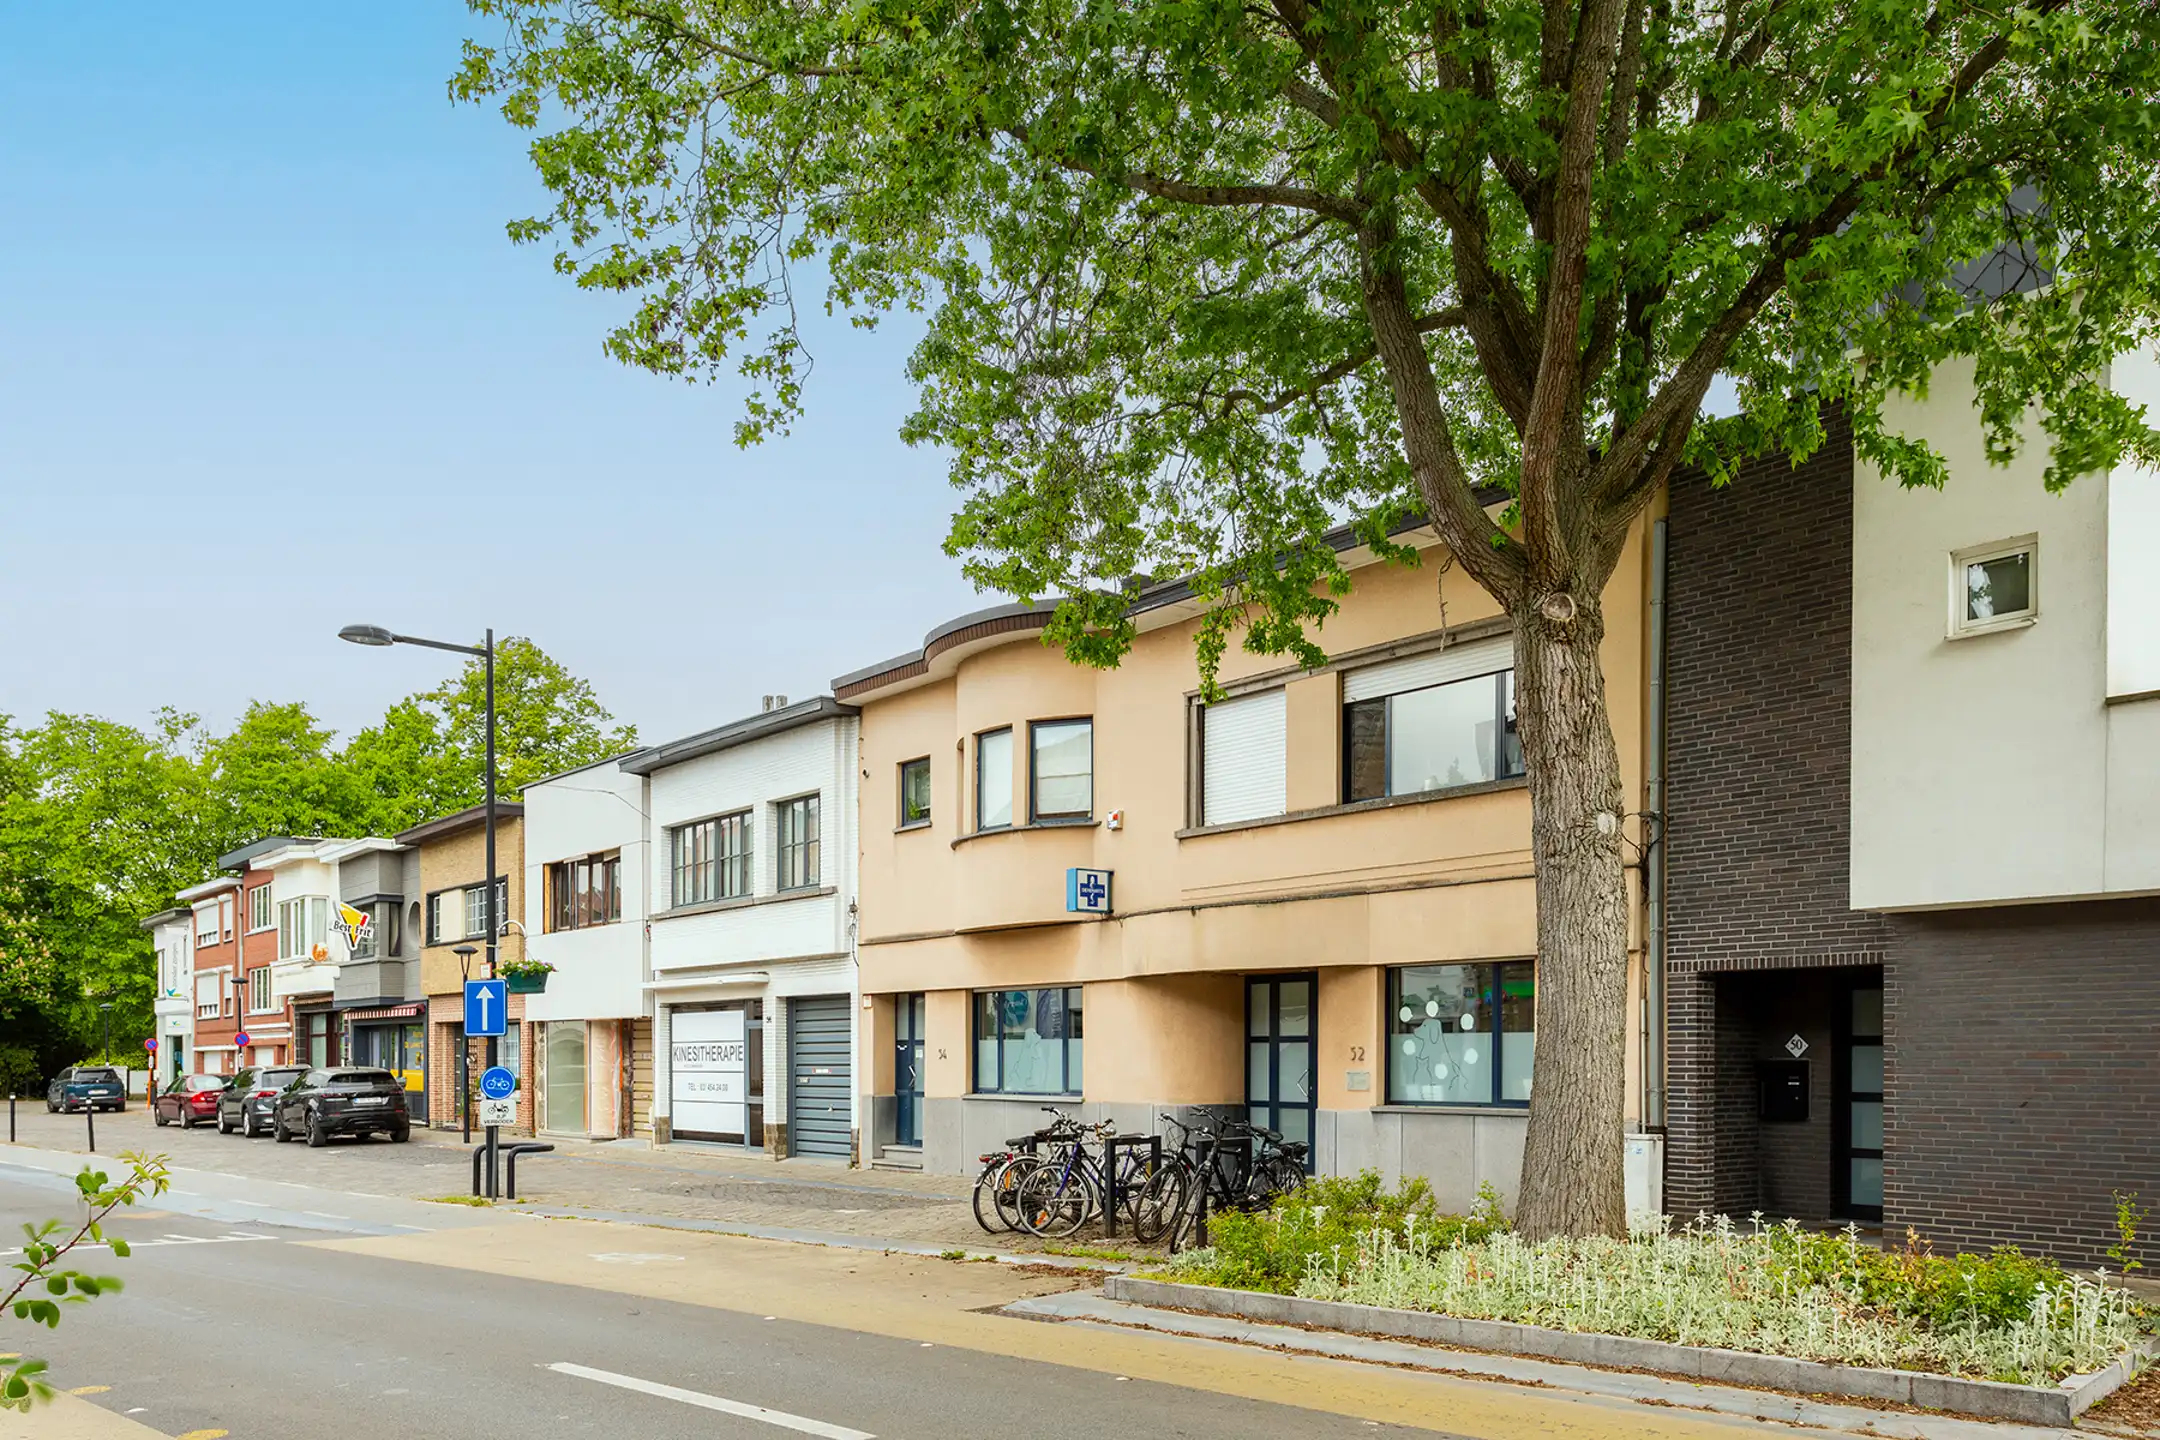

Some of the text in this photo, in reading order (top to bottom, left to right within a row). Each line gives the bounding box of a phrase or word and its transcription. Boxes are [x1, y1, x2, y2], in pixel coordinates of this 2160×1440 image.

[333, 920, 371, 937] Best Frit
[1790, 1038, 1803, 1050] 50
[673, 1044, 744, 1062] KINESITHERAPIE
[1350, 1046, 1365, 1062] 52
